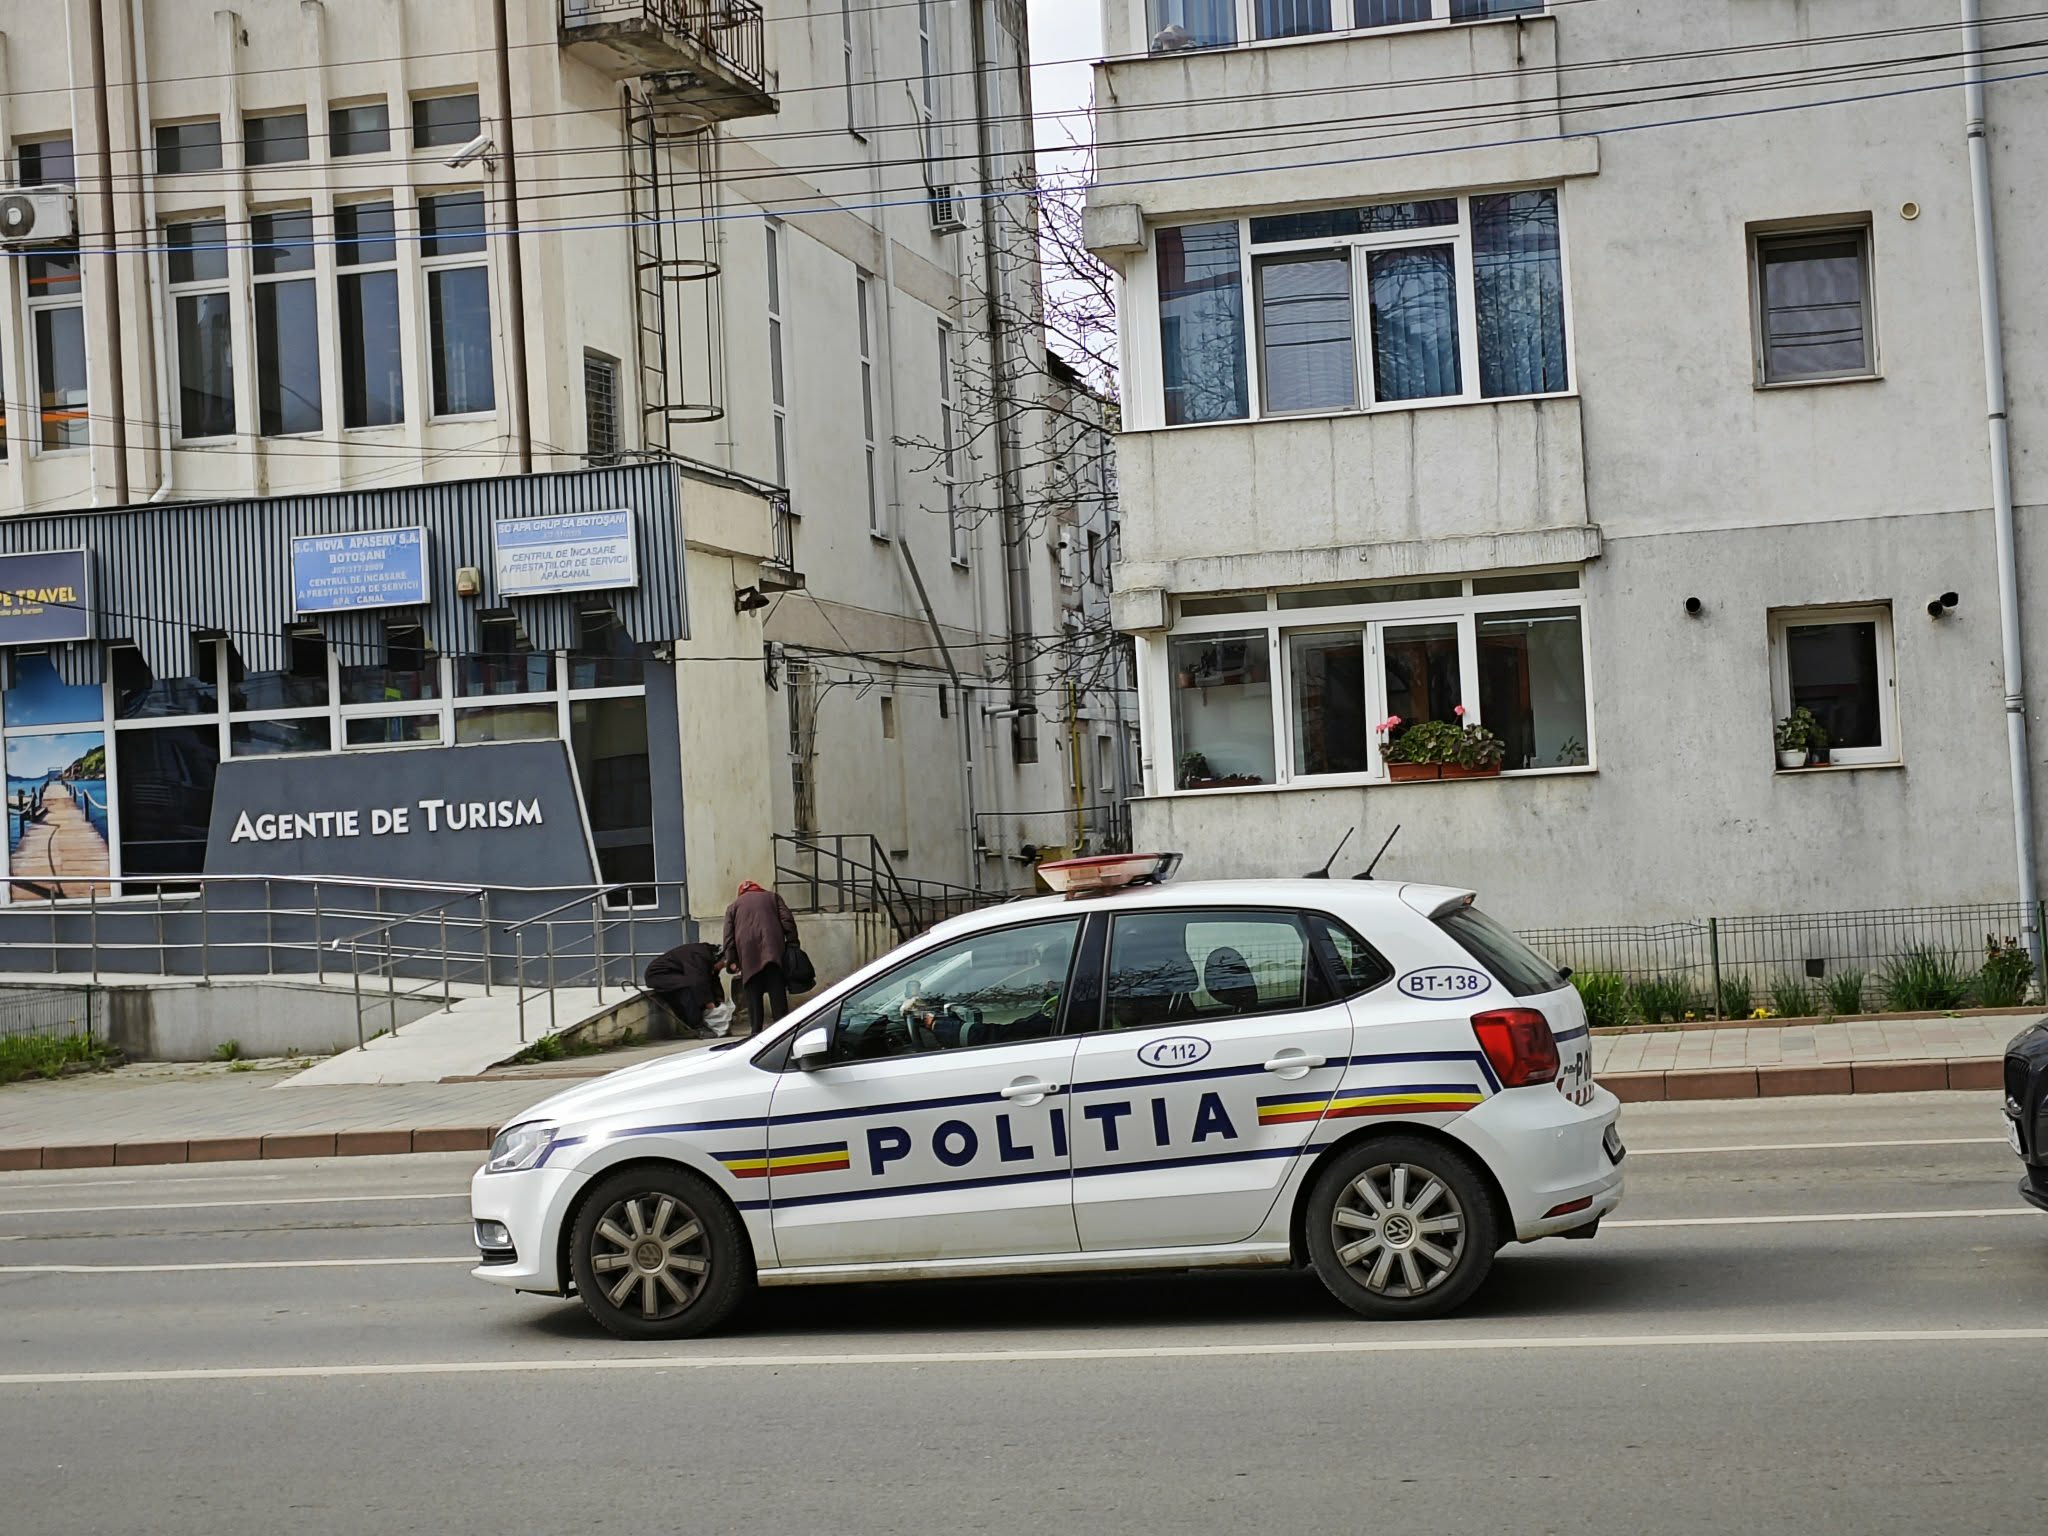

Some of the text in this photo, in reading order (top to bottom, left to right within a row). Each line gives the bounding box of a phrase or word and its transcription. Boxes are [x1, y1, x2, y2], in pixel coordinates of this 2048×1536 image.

[533, 520, 560, 530] GRUP
[562, 519, 575, 528] SA
[316, 540, 344, 551] NOVA
[350, 534, 396, 548] APASERV
[399, 532, 419, 544] S.A.
[512, 545, 616, 562] CENTRUL DE ÎNCASARE
[501, 566, 508, 574] A
[575, 558, 587, 567] DE
[590, 556, 628, 566] SERVICII
[298, 591, 305, 599] A
[368, 584, 380, 592] DE
[382, 581, 418, 591] SERVICII
[309, 577, 348, 587] CENTRUL
[16, 586, 77, 605] TRAVEL
[357, 594, 384, 603] CANAL
[231, 798, 543, 843] AGENTIE DE TURISM
[1410, 975, 1478, 992] BT-138
[1171, 1043, 1197, 1060] 112
[866, 1092, 1238, 1175] POLITIA
